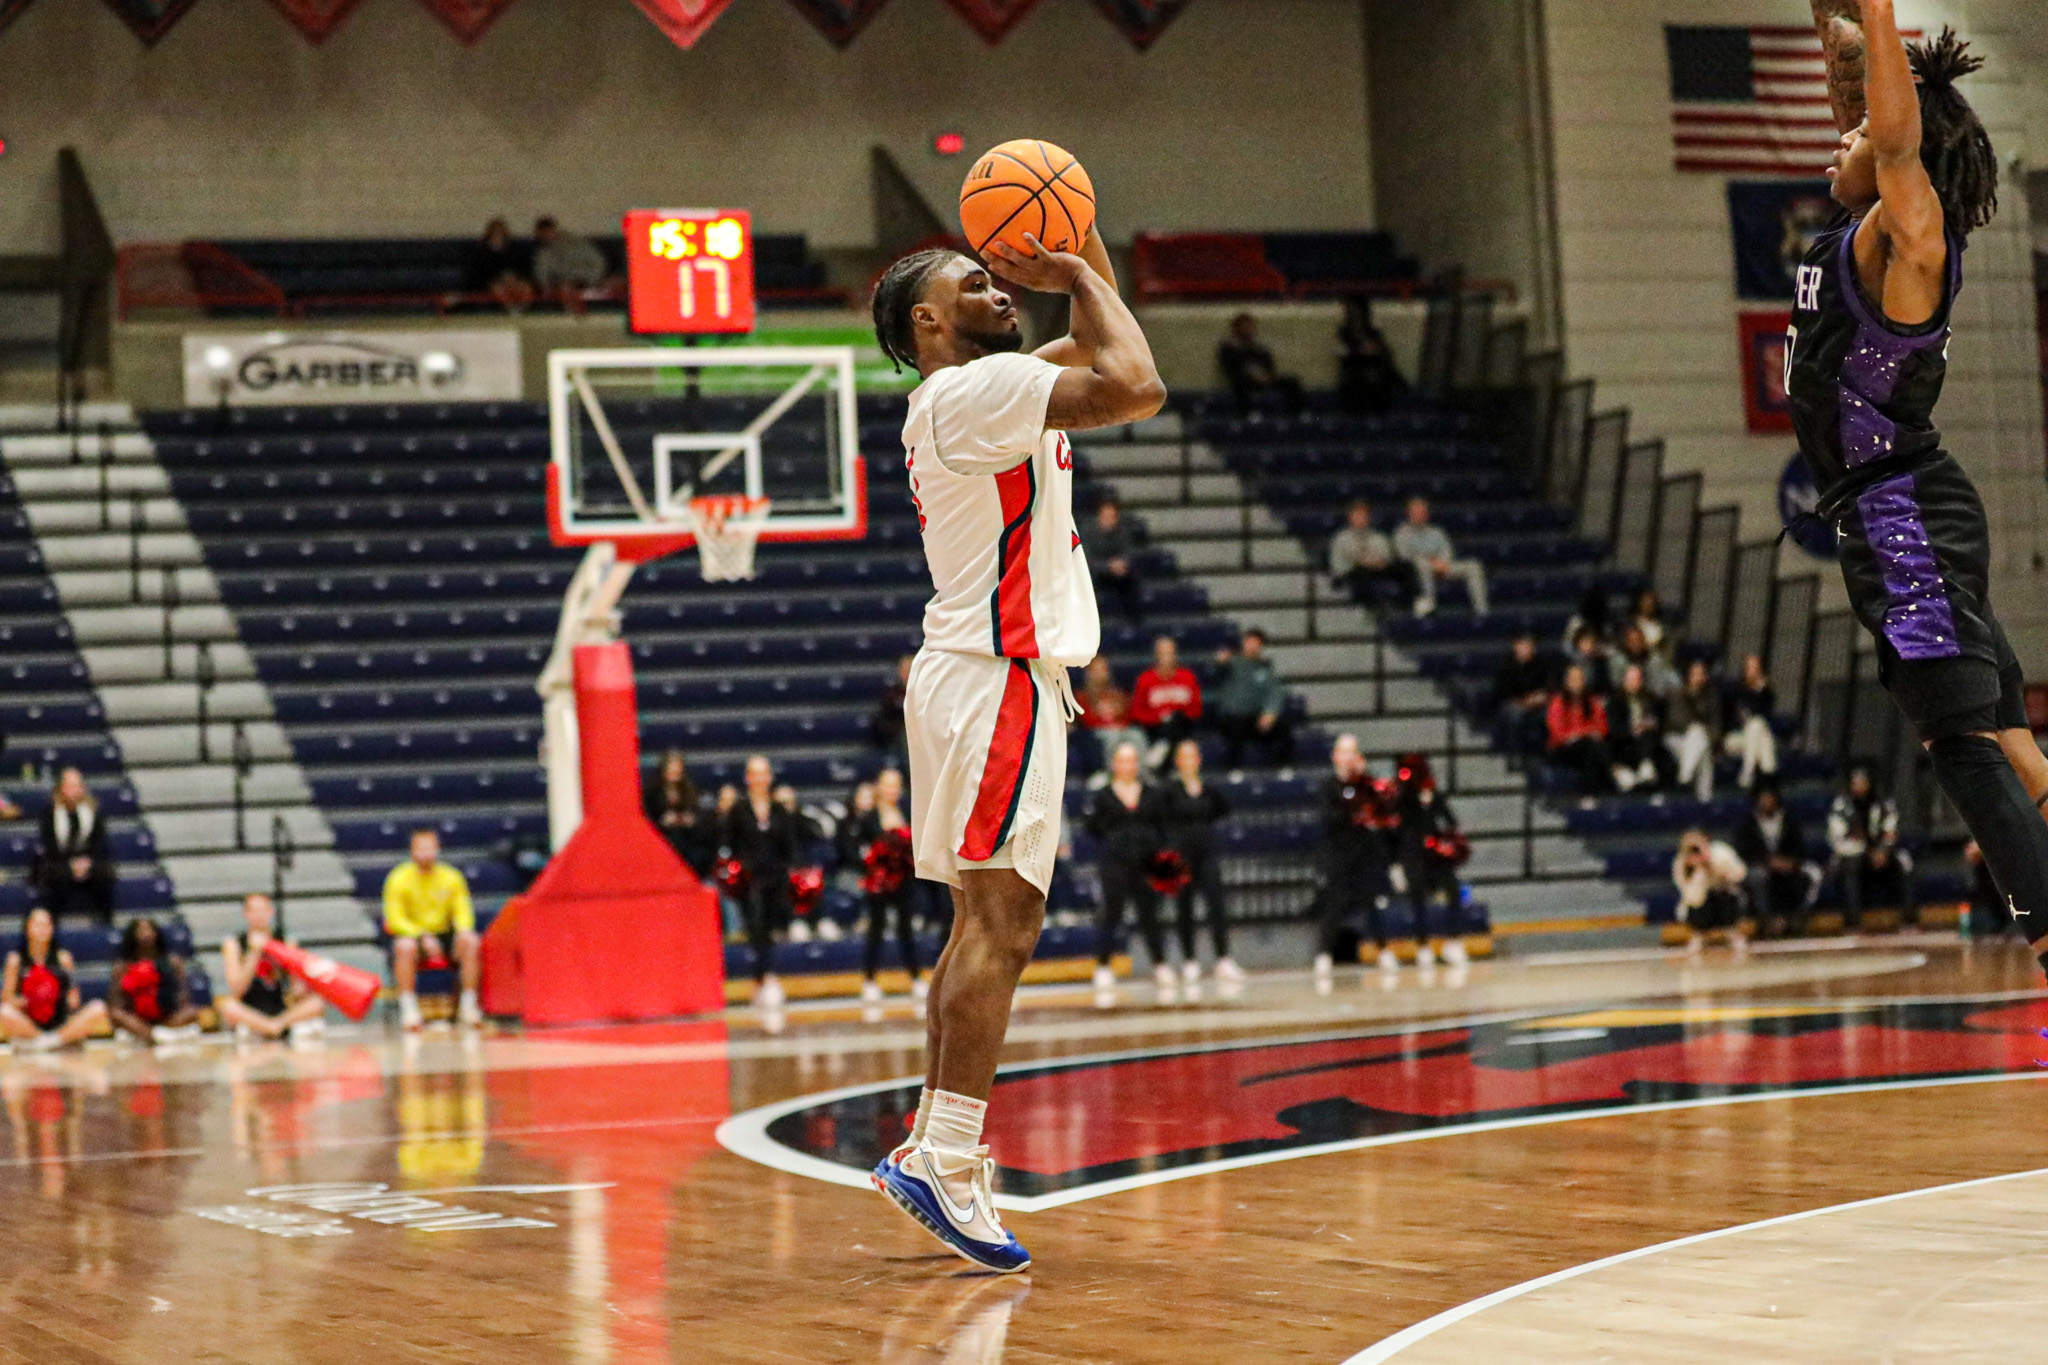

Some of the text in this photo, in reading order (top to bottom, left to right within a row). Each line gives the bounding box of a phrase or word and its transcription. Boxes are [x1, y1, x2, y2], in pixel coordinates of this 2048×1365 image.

[679, 258, 730, 318] 17
[1795, 265, 1823, 311] ER
[238, 354, 418, 391] GARBER
